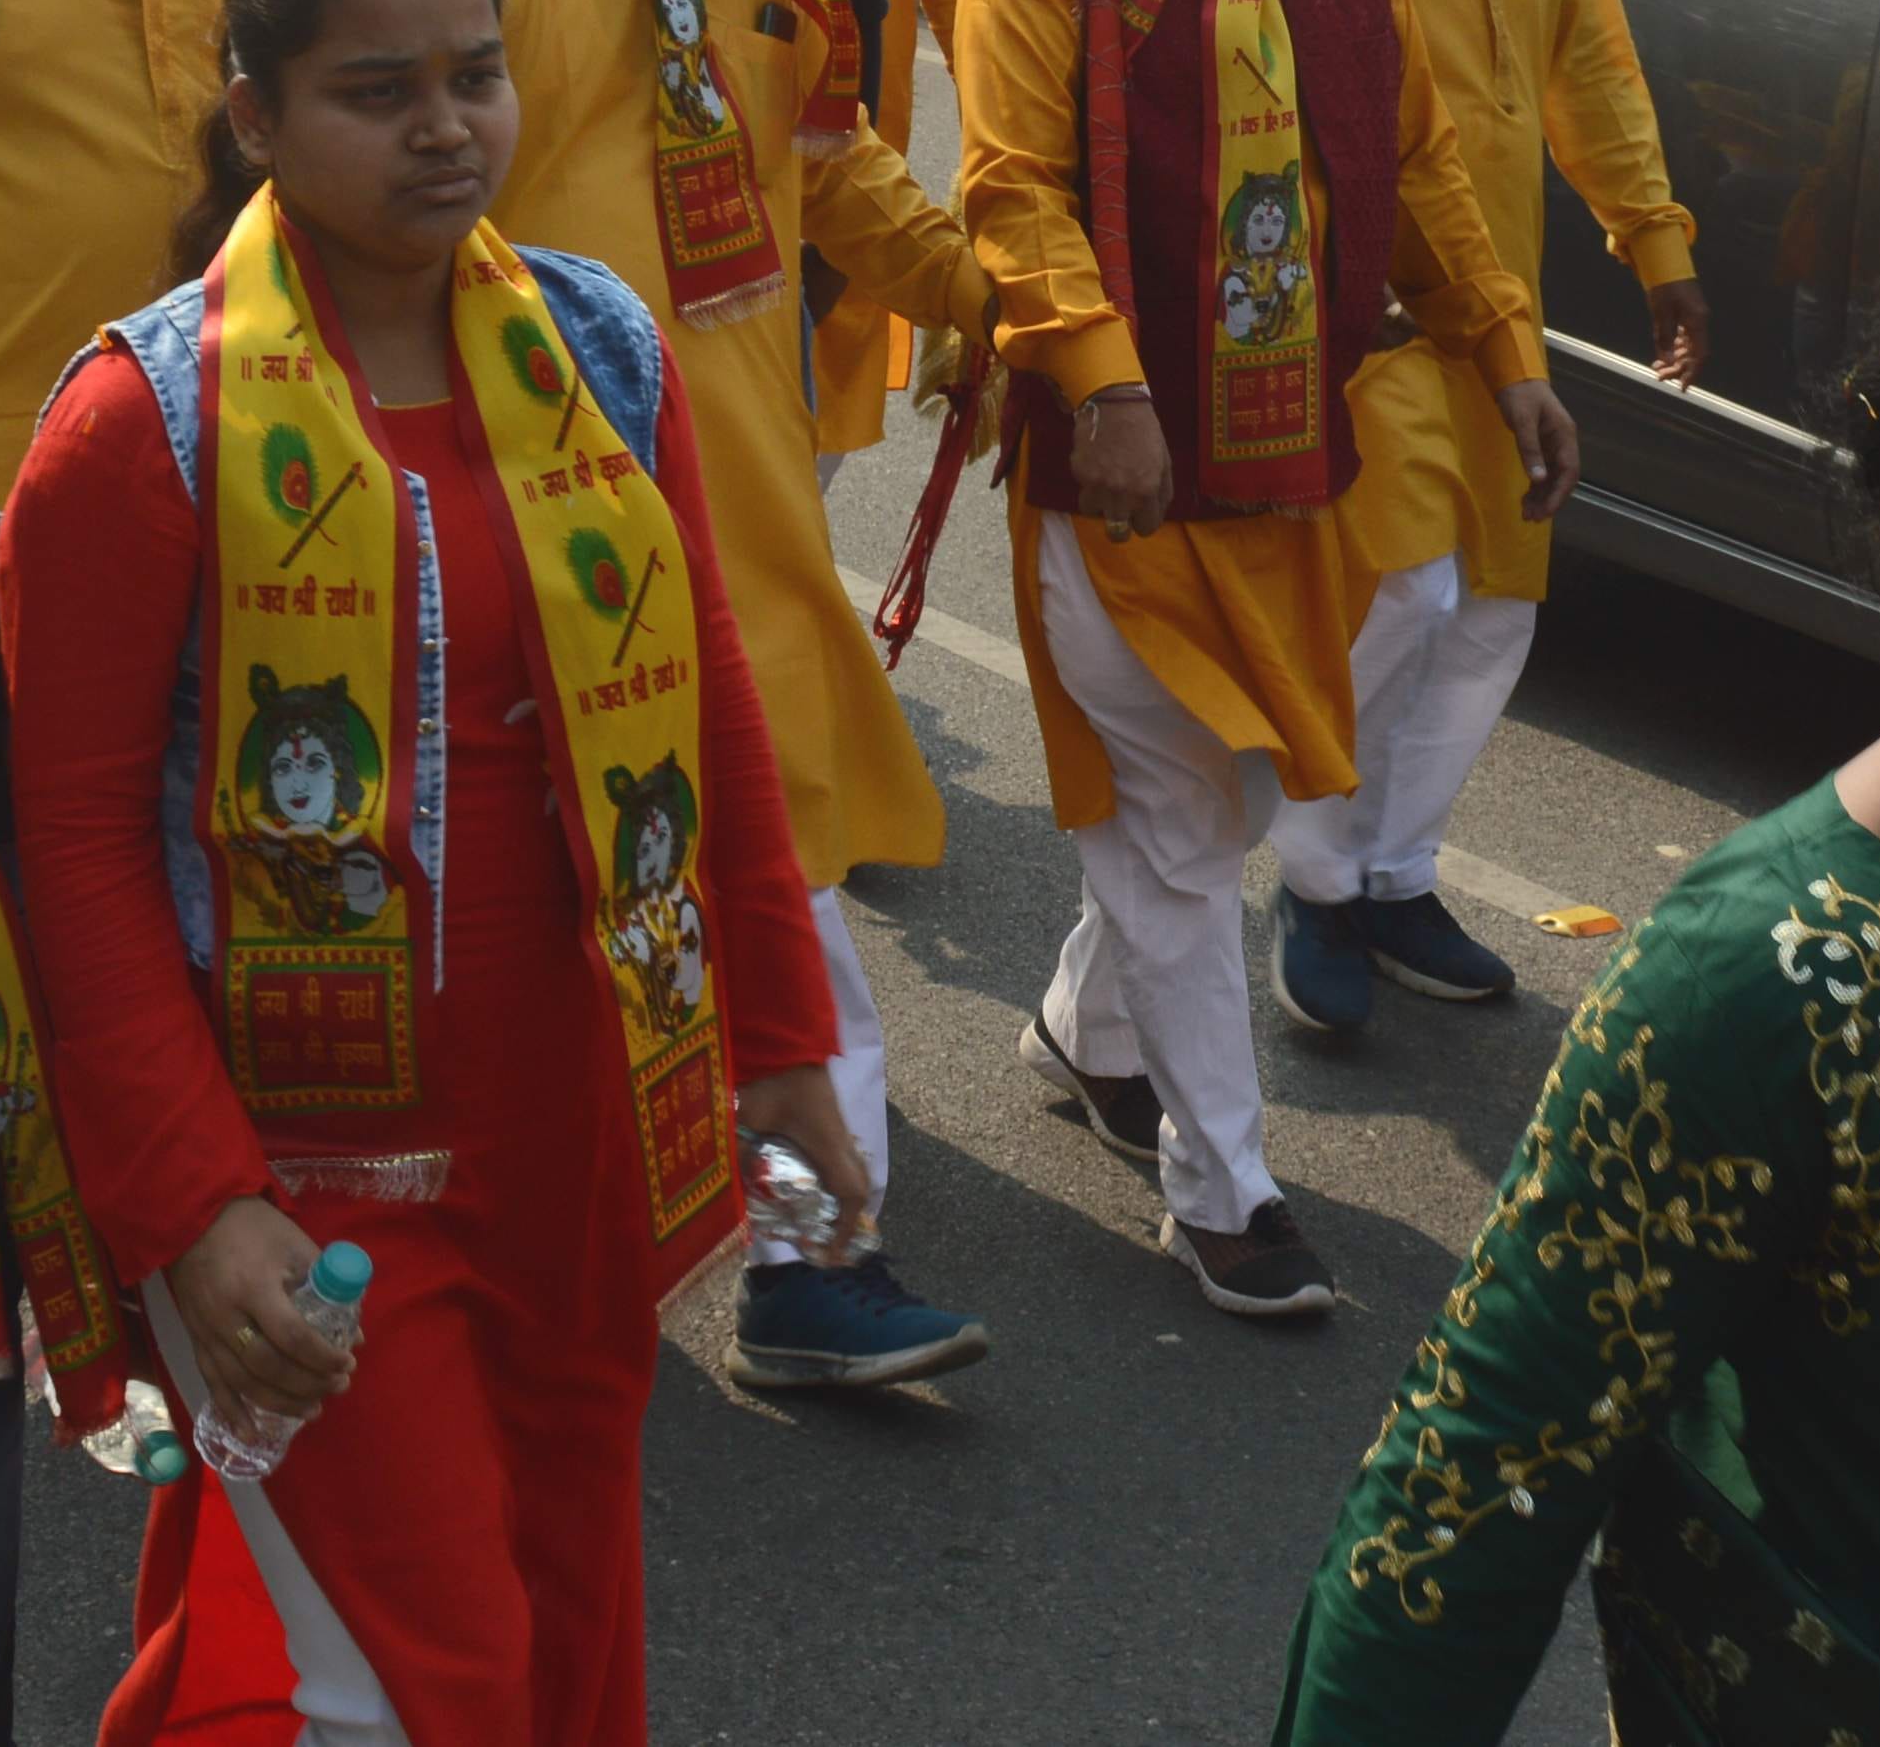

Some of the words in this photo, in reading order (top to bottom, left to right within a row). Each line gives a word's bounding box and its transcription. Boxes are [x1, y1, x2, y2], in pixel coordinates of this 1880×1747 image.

[260, 355, 289, 382] जय
[295, 346, 313, 383] श्री
[538, 468, 571, 498] जय
[572, 449, 595, 489] श्री
[254, 584, 287, 615] जय
[293, 574, 317, 617] श्री
[324, 577, 358, 617] राधे
[593, 680, 628, 711] जय
[629, 661, 650, 704] श्री
[652, 654, 677, 694] राधे
[255, 990, 287, 1018] जय
[300, 975, 321, 1017] श्री
[336, 981, 376, 1021] राधे
